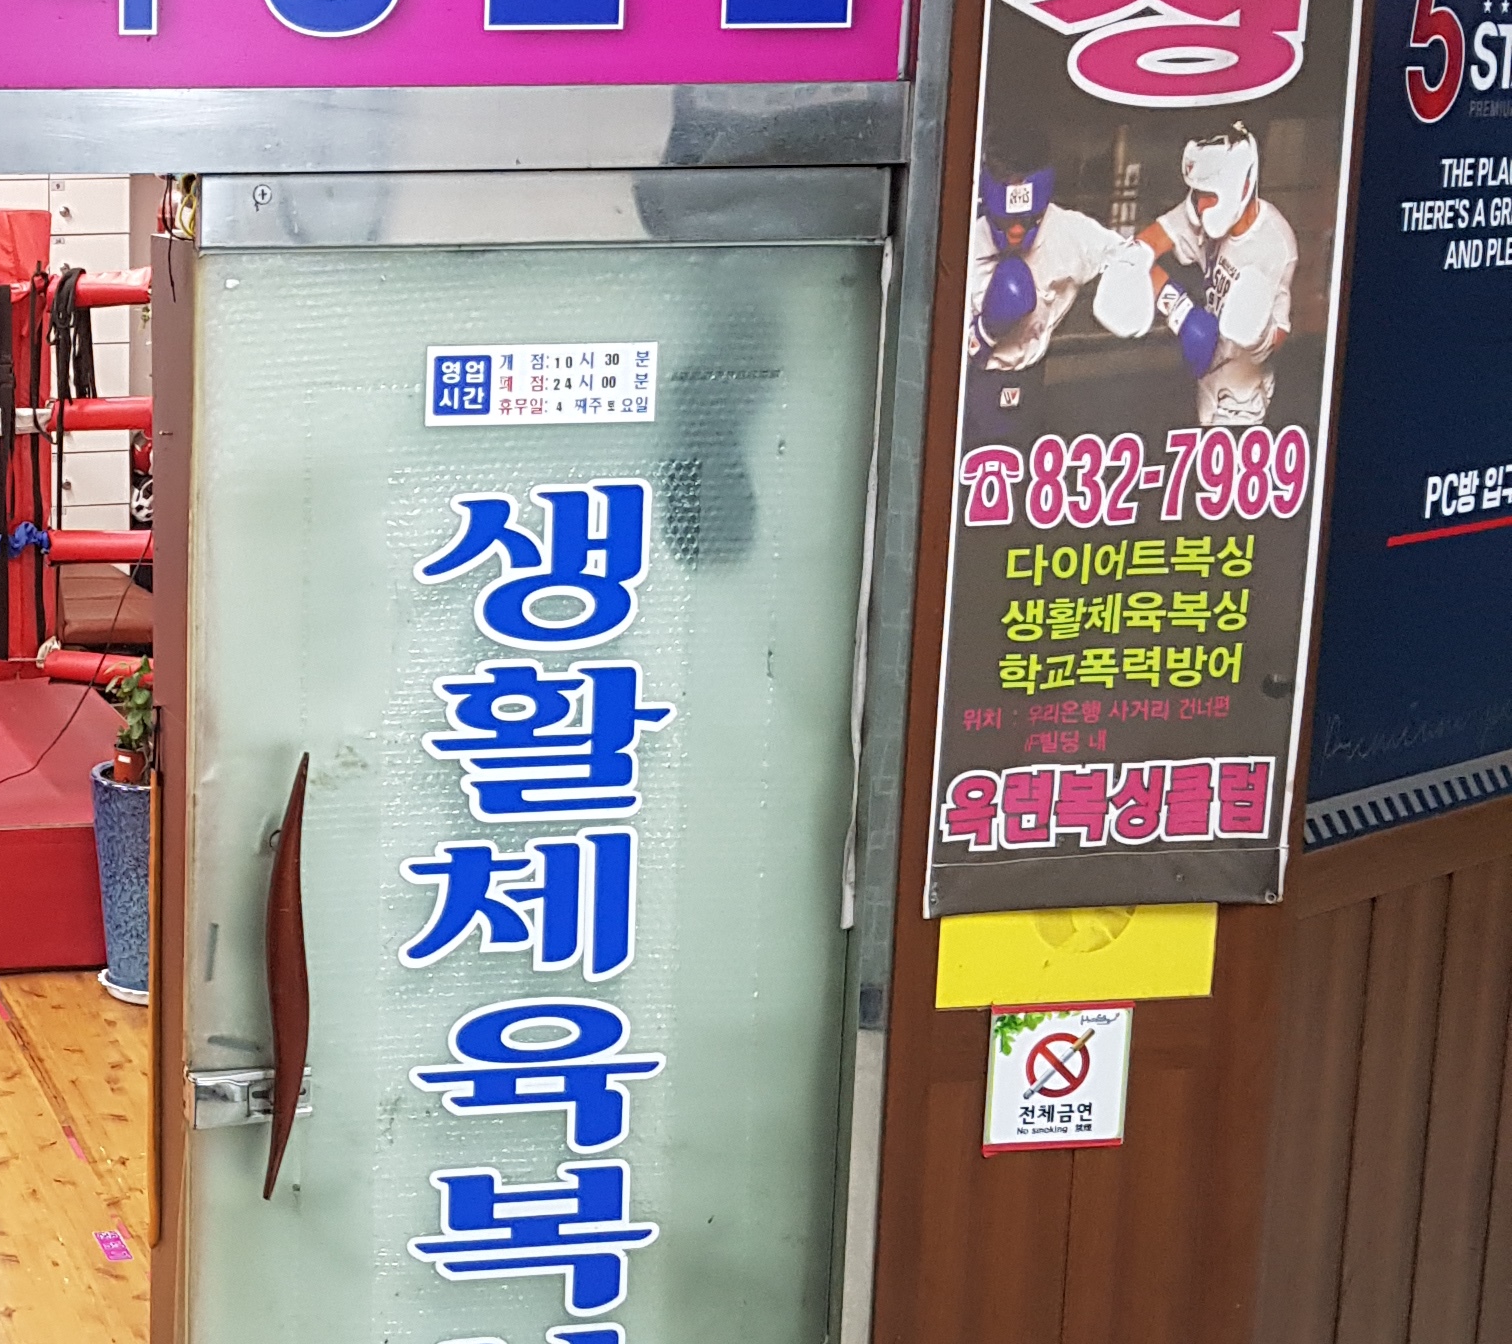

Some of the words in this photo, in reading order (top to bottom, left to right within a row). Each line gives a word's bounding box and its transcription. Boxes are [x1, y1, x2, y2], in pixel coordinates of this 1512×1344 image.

[1470, 20, 1512, 92] ST
[1441, 158, 1476, 188] THE
[1477, 156, 1512, 187] PLA
[1401, 198, 1470, 232] THERE'S
[1472, 198, 1486, 228] A
[1490, 197, 1512, 227] GR
[1444, 239, 1484, 270] AND
[441, 360, 485, 384] 영업
[579, 351, 594, 369] 시
[605, 353, 620, 366] 30
[635, 351, 650, 368] 분
[439, 387, 485, 410] 시간
[579, 373, 594, 391] 시
[601, 375, 617, 389] 00
[634, 373, 650, 390] 분
[1025, 425, 1310, 529] 832-7989
[1425, 470, 1480, 519] PC방
[1005, 534, 1256, 587] 다이어트복싱
[1000, 587, 1250, 642] 생활체육복싱
[998, 642, 1244, 695] 학교폭력방어
[1109, 699, 1170, 723] 사거리
[1179, 695, 1230, 721] 건너편
[940, 756, 1276, 852] 옥련복싱클럽
[1018, 1102, 1093, 1125] 전체금연
